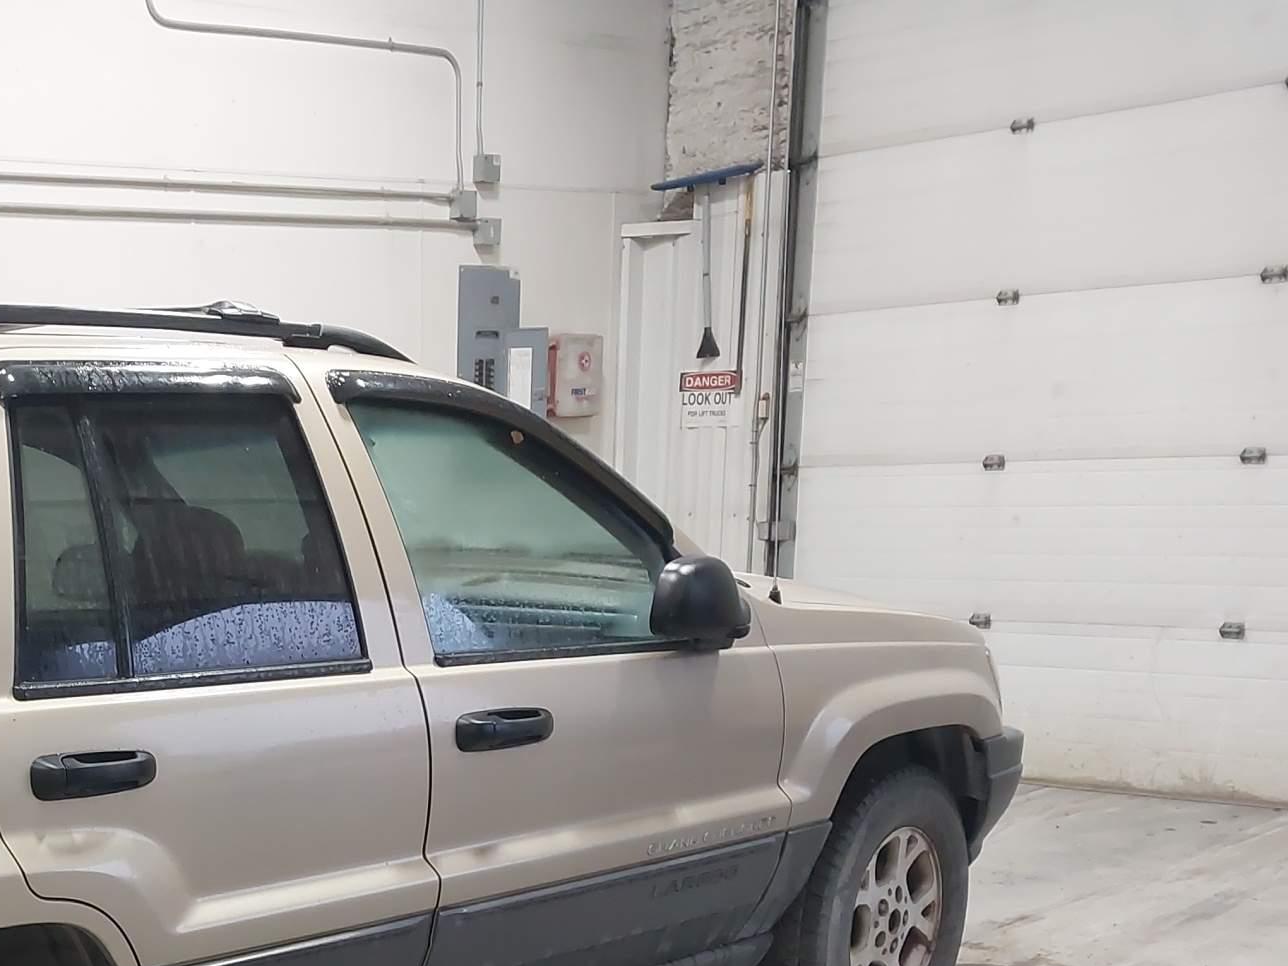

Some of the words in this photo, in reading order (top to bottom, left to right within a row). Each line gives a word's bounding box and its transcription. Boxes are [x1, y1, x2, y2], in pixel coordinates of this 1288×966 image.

[685, 375, 732, 388] DANGER
[682, 392, 711, 406] LOOK
[713, 391, 733, 405] OUT
